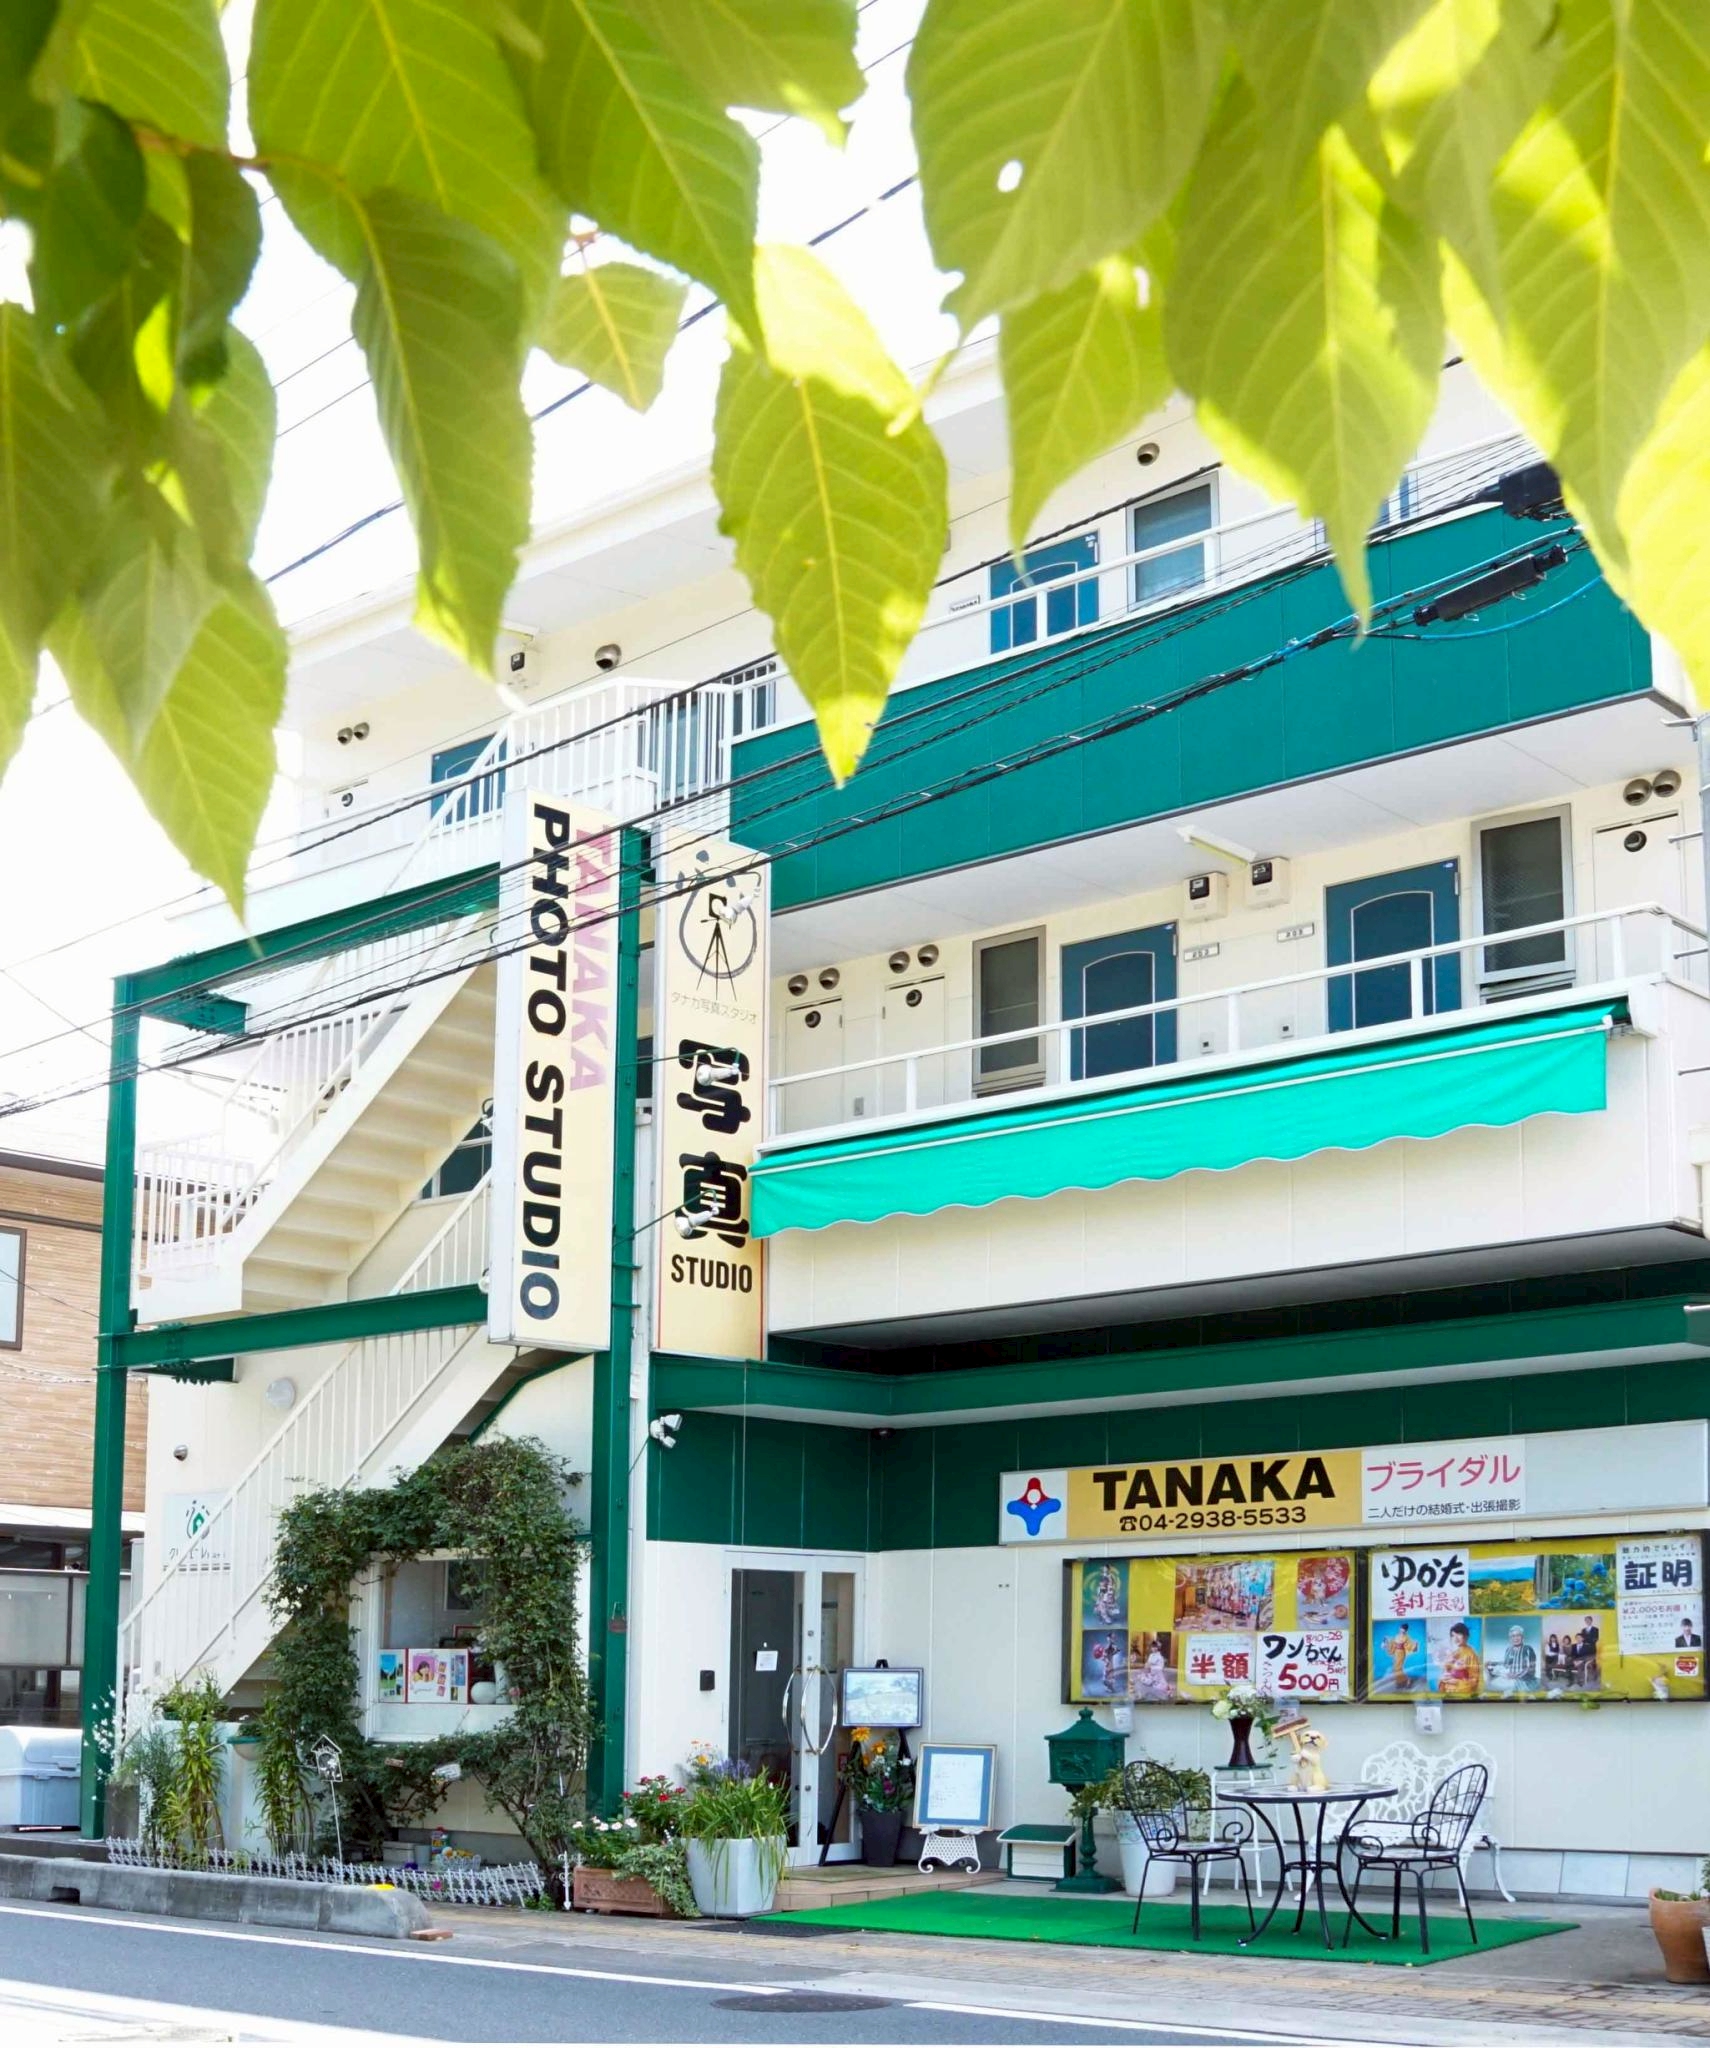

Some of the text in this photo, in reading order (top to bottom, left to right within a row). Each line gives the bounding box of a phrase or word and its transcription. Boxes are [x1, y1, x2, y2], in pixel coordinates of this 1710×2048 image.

[569, 824, 612, 1091] TANAKA
[671, 991, 757, 1024] タナカ写真スタジオ
[519, 803, 570, 1320] PHOTO STUDIO
[675, 1039, 751, 1249] 写真
[671, 1254, 753, 1293] STUDIO
[1092, 1456, 1336, 1511] TANAKA
[1366, 1454, 1521, 1492] ブライダル
[1139, 1506, 1307, 1531] 04-2938-5533
[1381, 1554, 1465, 1592] ゆかた
[1624, 1559, 1693, 1590] 証明
[1190, 1652, 1249, 1680] 半額
[1278, 1663, 1340, 1691] 500円
